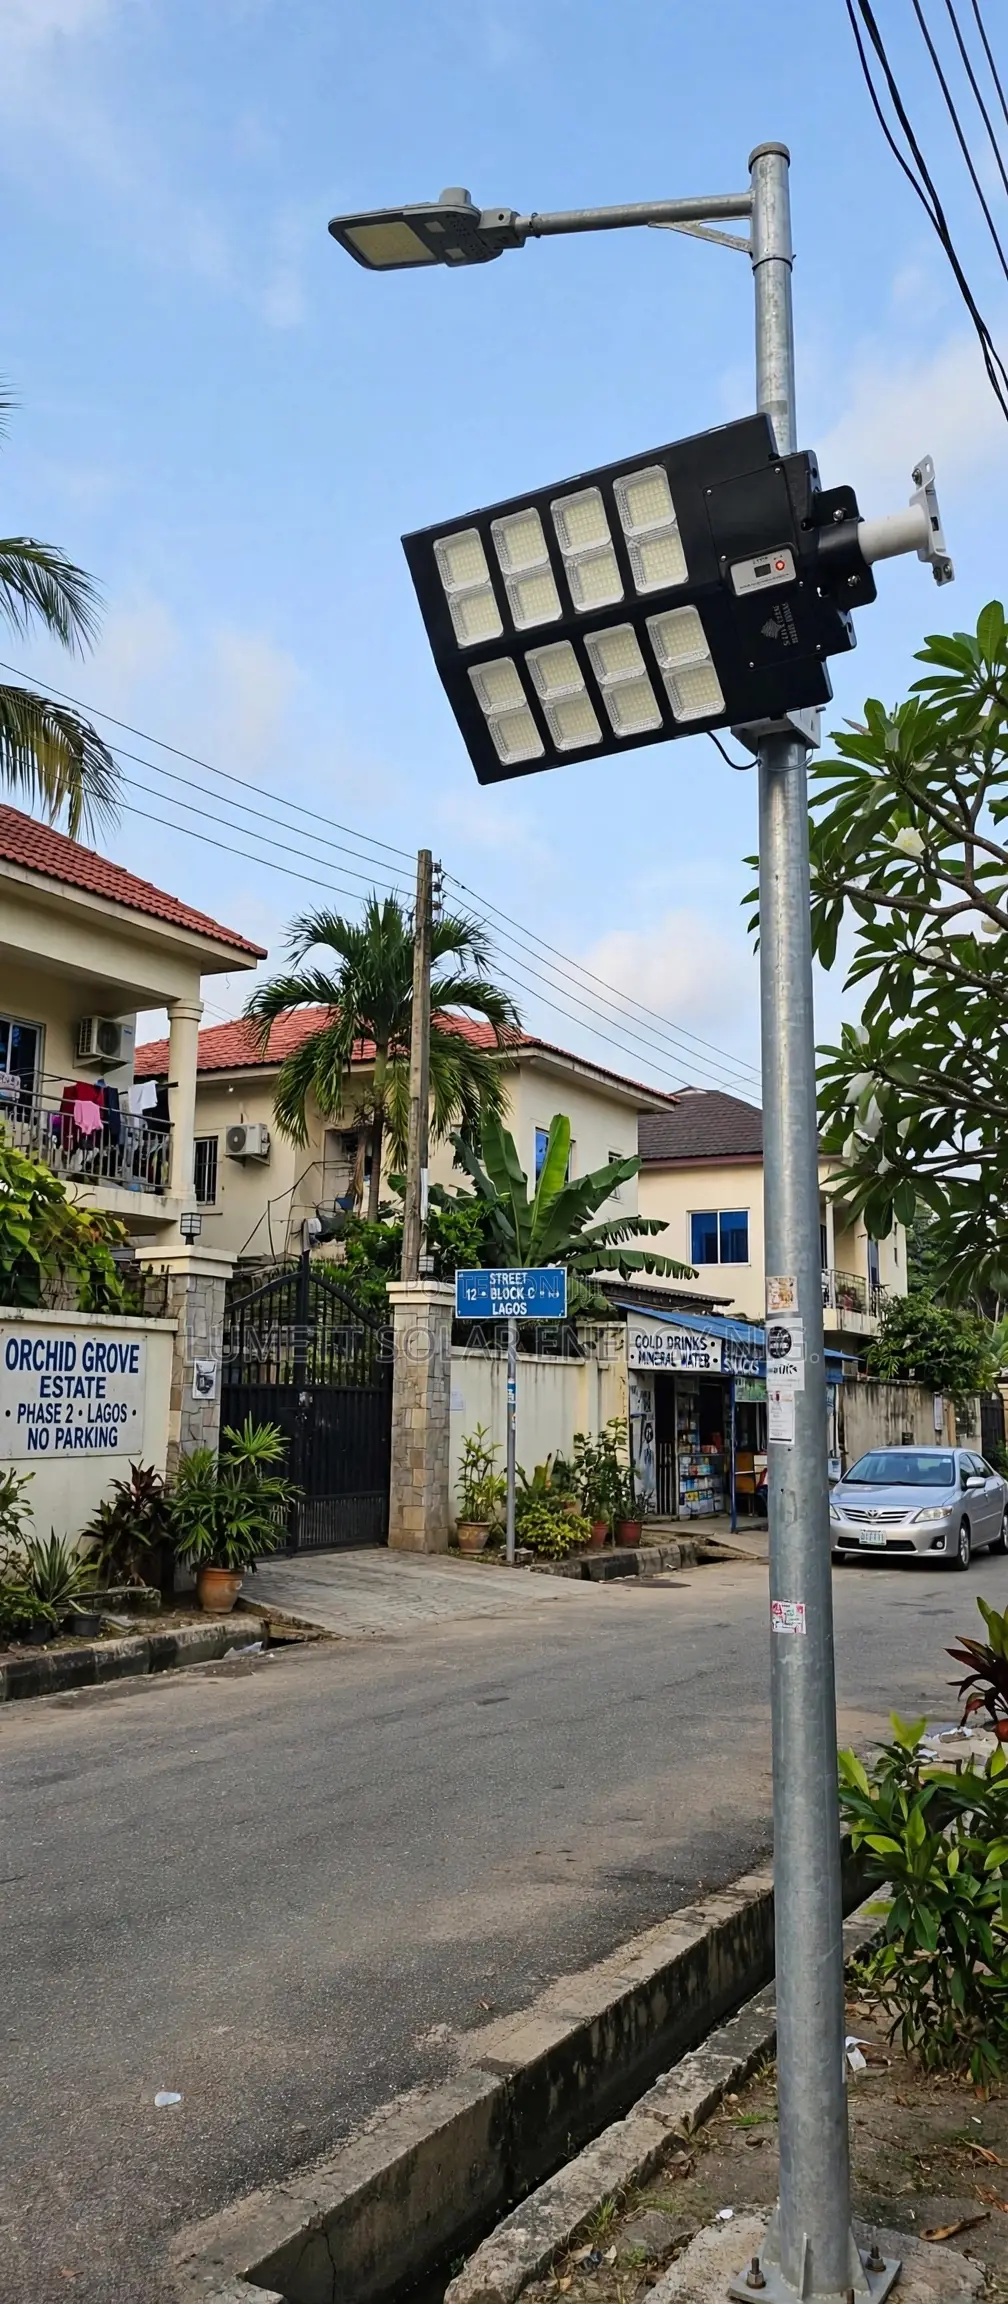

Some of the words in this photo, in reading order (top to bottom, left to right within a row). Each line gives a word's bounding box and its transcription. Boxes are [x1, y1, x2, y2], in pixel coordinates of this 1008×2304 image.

[489, 1273, 528, 1285] STREET
[466, 1288, 477, 1301] 12
[490, 1287, 525, 1300] BLOCK
[527, 1287, 535, 1300] C
[492, 1302, 528, 1315] LAGOS
[635, 1335, 663, 1349] COLD
[667, 1336, 708, 1350] DRINKS
[5, 1338, 77, 1372] ORCHID
[82, 1341, 140, 1374] GROVE
[40, 1375, 107, 1399] ESTATE
[17, 1403, 62, 1424] PHASE
[65, 1403, 74, 1424] 2
[87, 1403, 128, 1423] LAGOS
[27, 1427, 50, 1450] NO
[55, 1426, 118, 1450] PARKING
